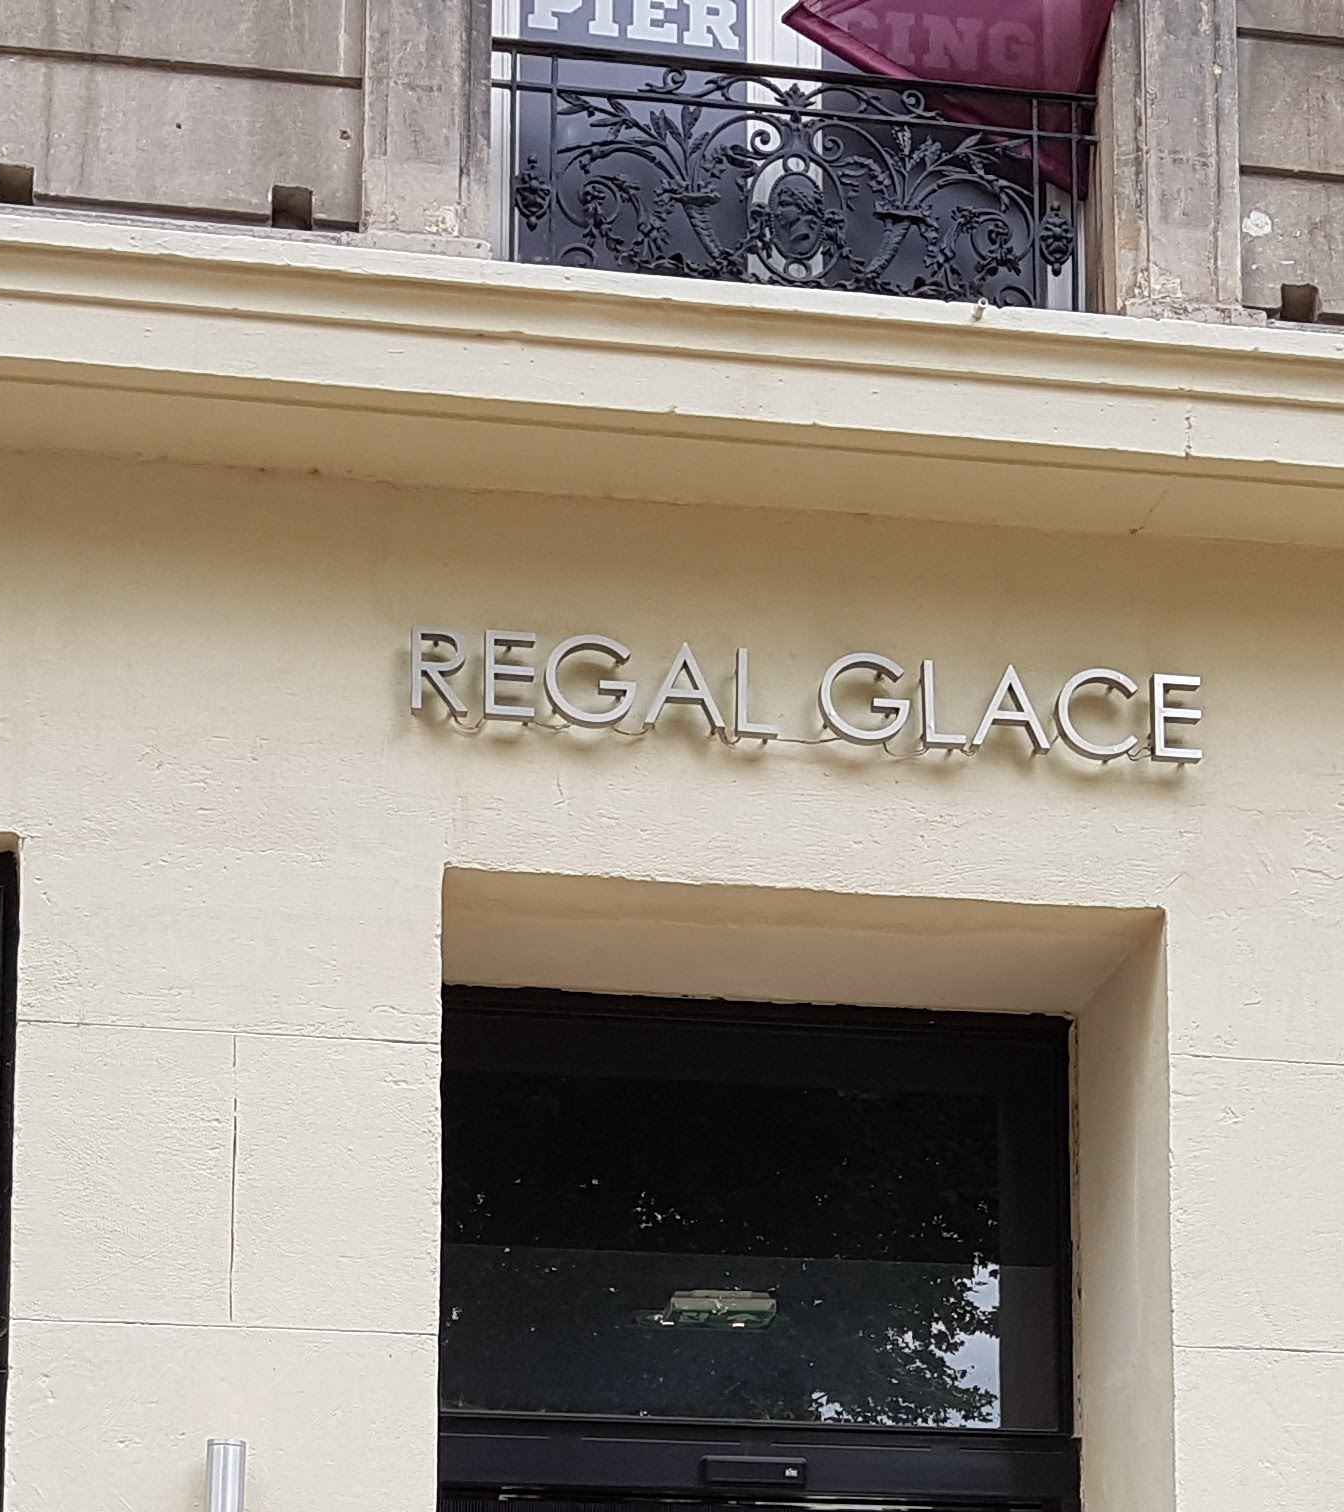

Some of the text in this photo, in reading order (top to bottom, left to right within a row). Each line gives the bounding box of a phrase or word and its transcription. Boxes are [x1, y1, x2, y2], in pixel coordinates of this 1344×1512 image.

[527, 0, 740, 51] PIER
[410, 625, 1202, 764] REGAL GLACE
